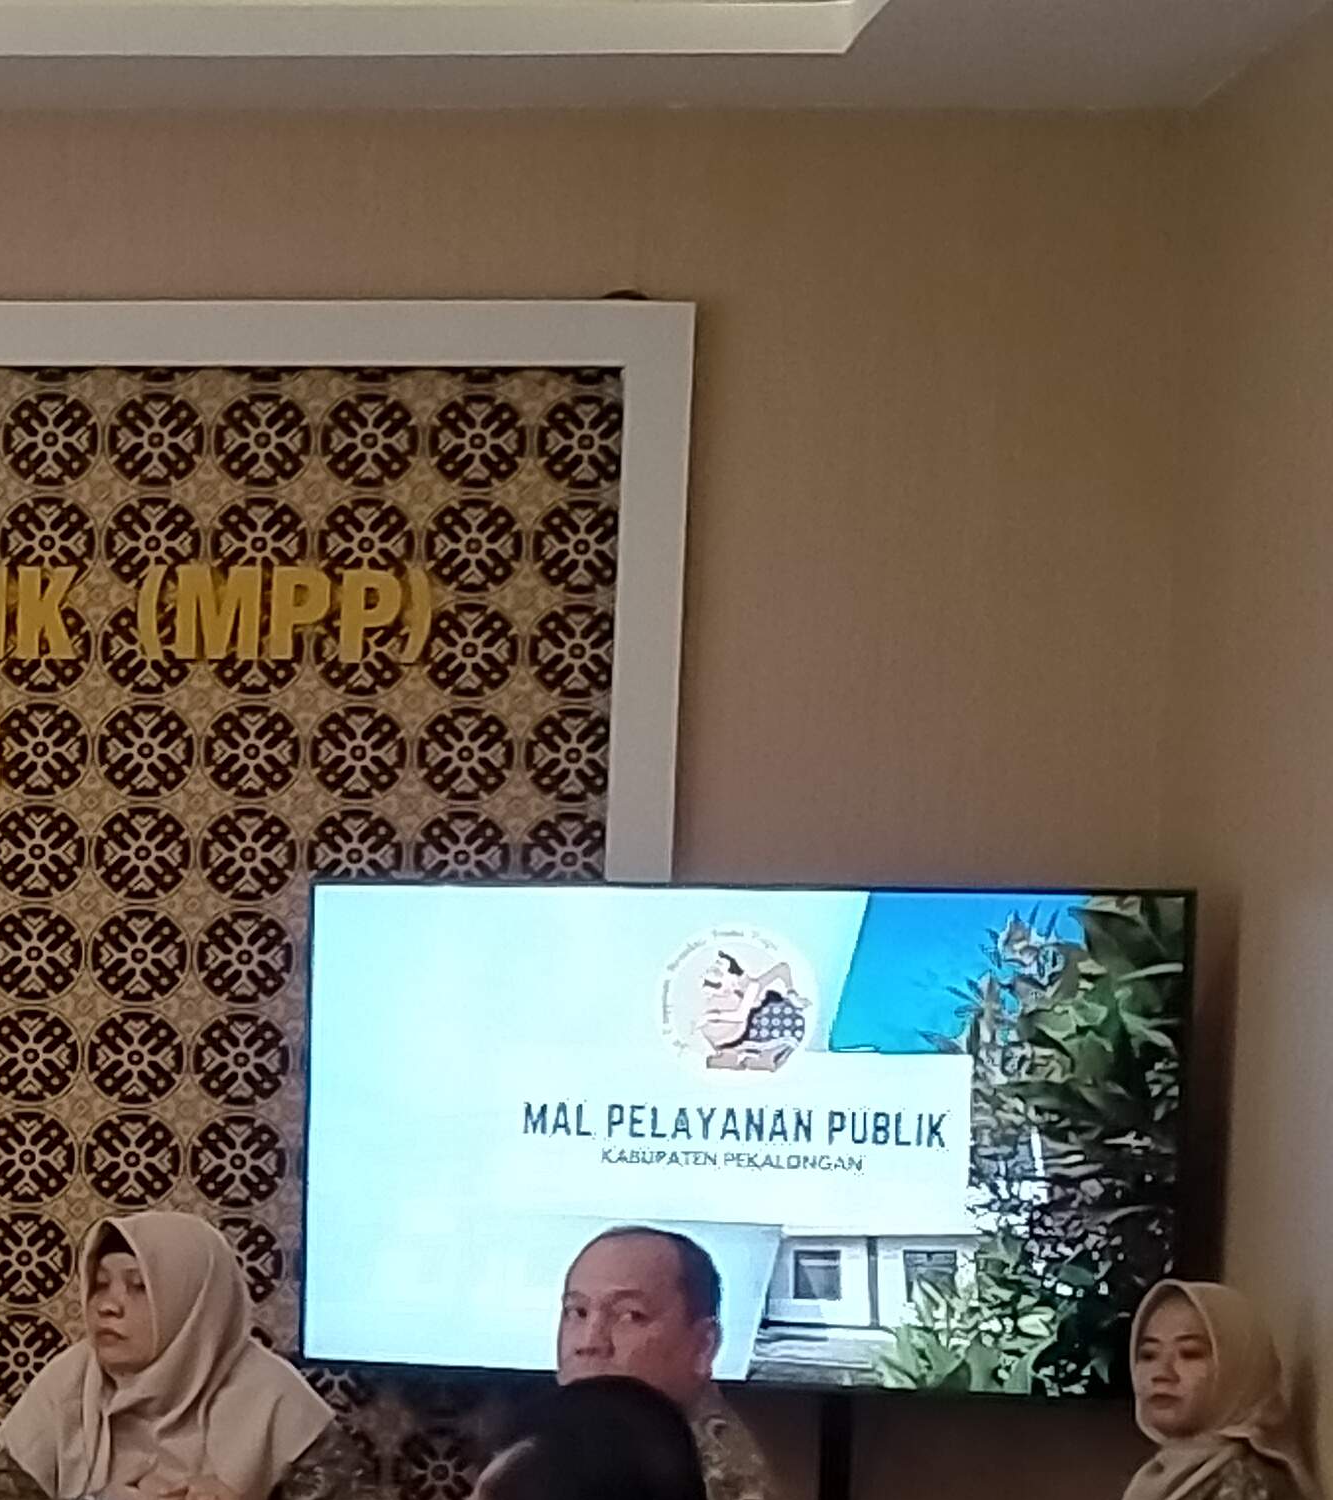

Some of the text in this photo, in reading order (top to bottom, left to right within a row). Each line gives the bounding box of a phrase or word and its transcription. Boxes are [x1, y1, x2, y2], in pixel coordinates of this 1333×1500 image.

[136, 564, 433, 665] (MPP)
[523, 1101, 946, 1148] MAL PELAYANAN PUBLIK
[601, 1148, 863, 1172] KABUPATEN PEKALONGAN
